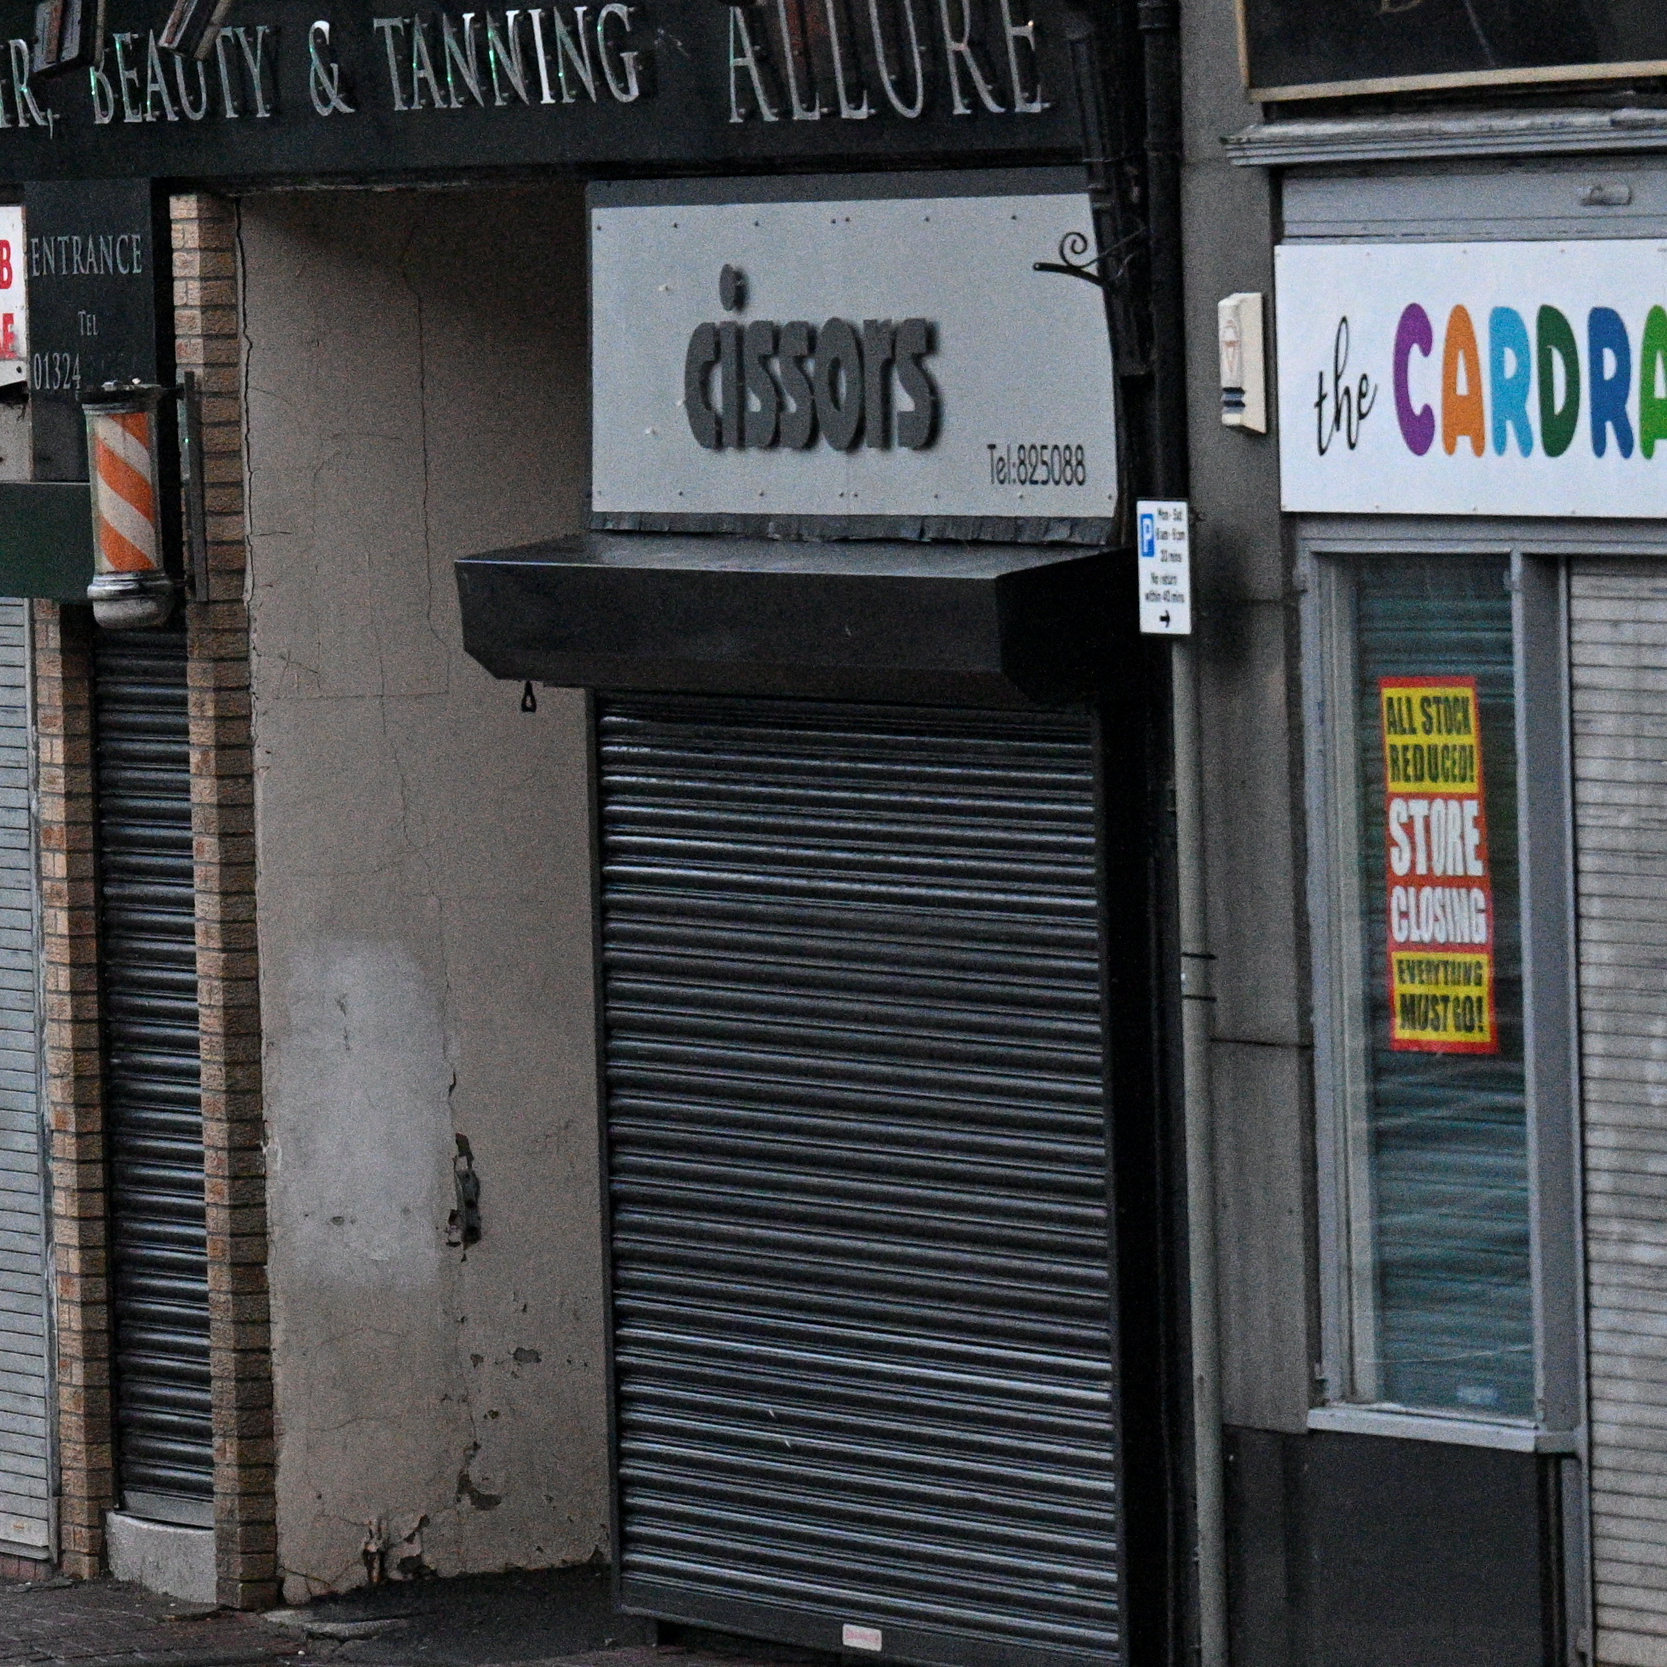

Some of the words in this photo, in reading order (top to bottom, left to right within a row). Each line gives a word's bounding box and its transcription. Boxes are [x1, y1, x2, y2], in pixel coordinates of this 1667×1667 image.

[88, 25, 271, 125] BEAUTY
[308, 19, 355, 117] &
[373, 2, 639, 113] TANNING
[30, 232, 143, 277] ENTRANCE
[33, 351, 82, 392] 01324
[683, 263, 942, 454] cissors
[1314, 315, 1378, 456] the
[1393, 302, 1667, 460] CARDRA
[986, 443, 1087, 487] Tel:825088
[1386, 695, 1418, 736] ALL
[1420, 694, 1472, 736] STOCK
[1388, 743, 1475, 784] REDUCED!
[1388, 797, 1485, 877] STORE
[1390, 885, 1489, 945] CLOSING
[1396, 959, 1484, 987] EVERYTHING
[1399, 993, 1451, 1032] MUST
[1452, 994, 1485, 1034] GO!
